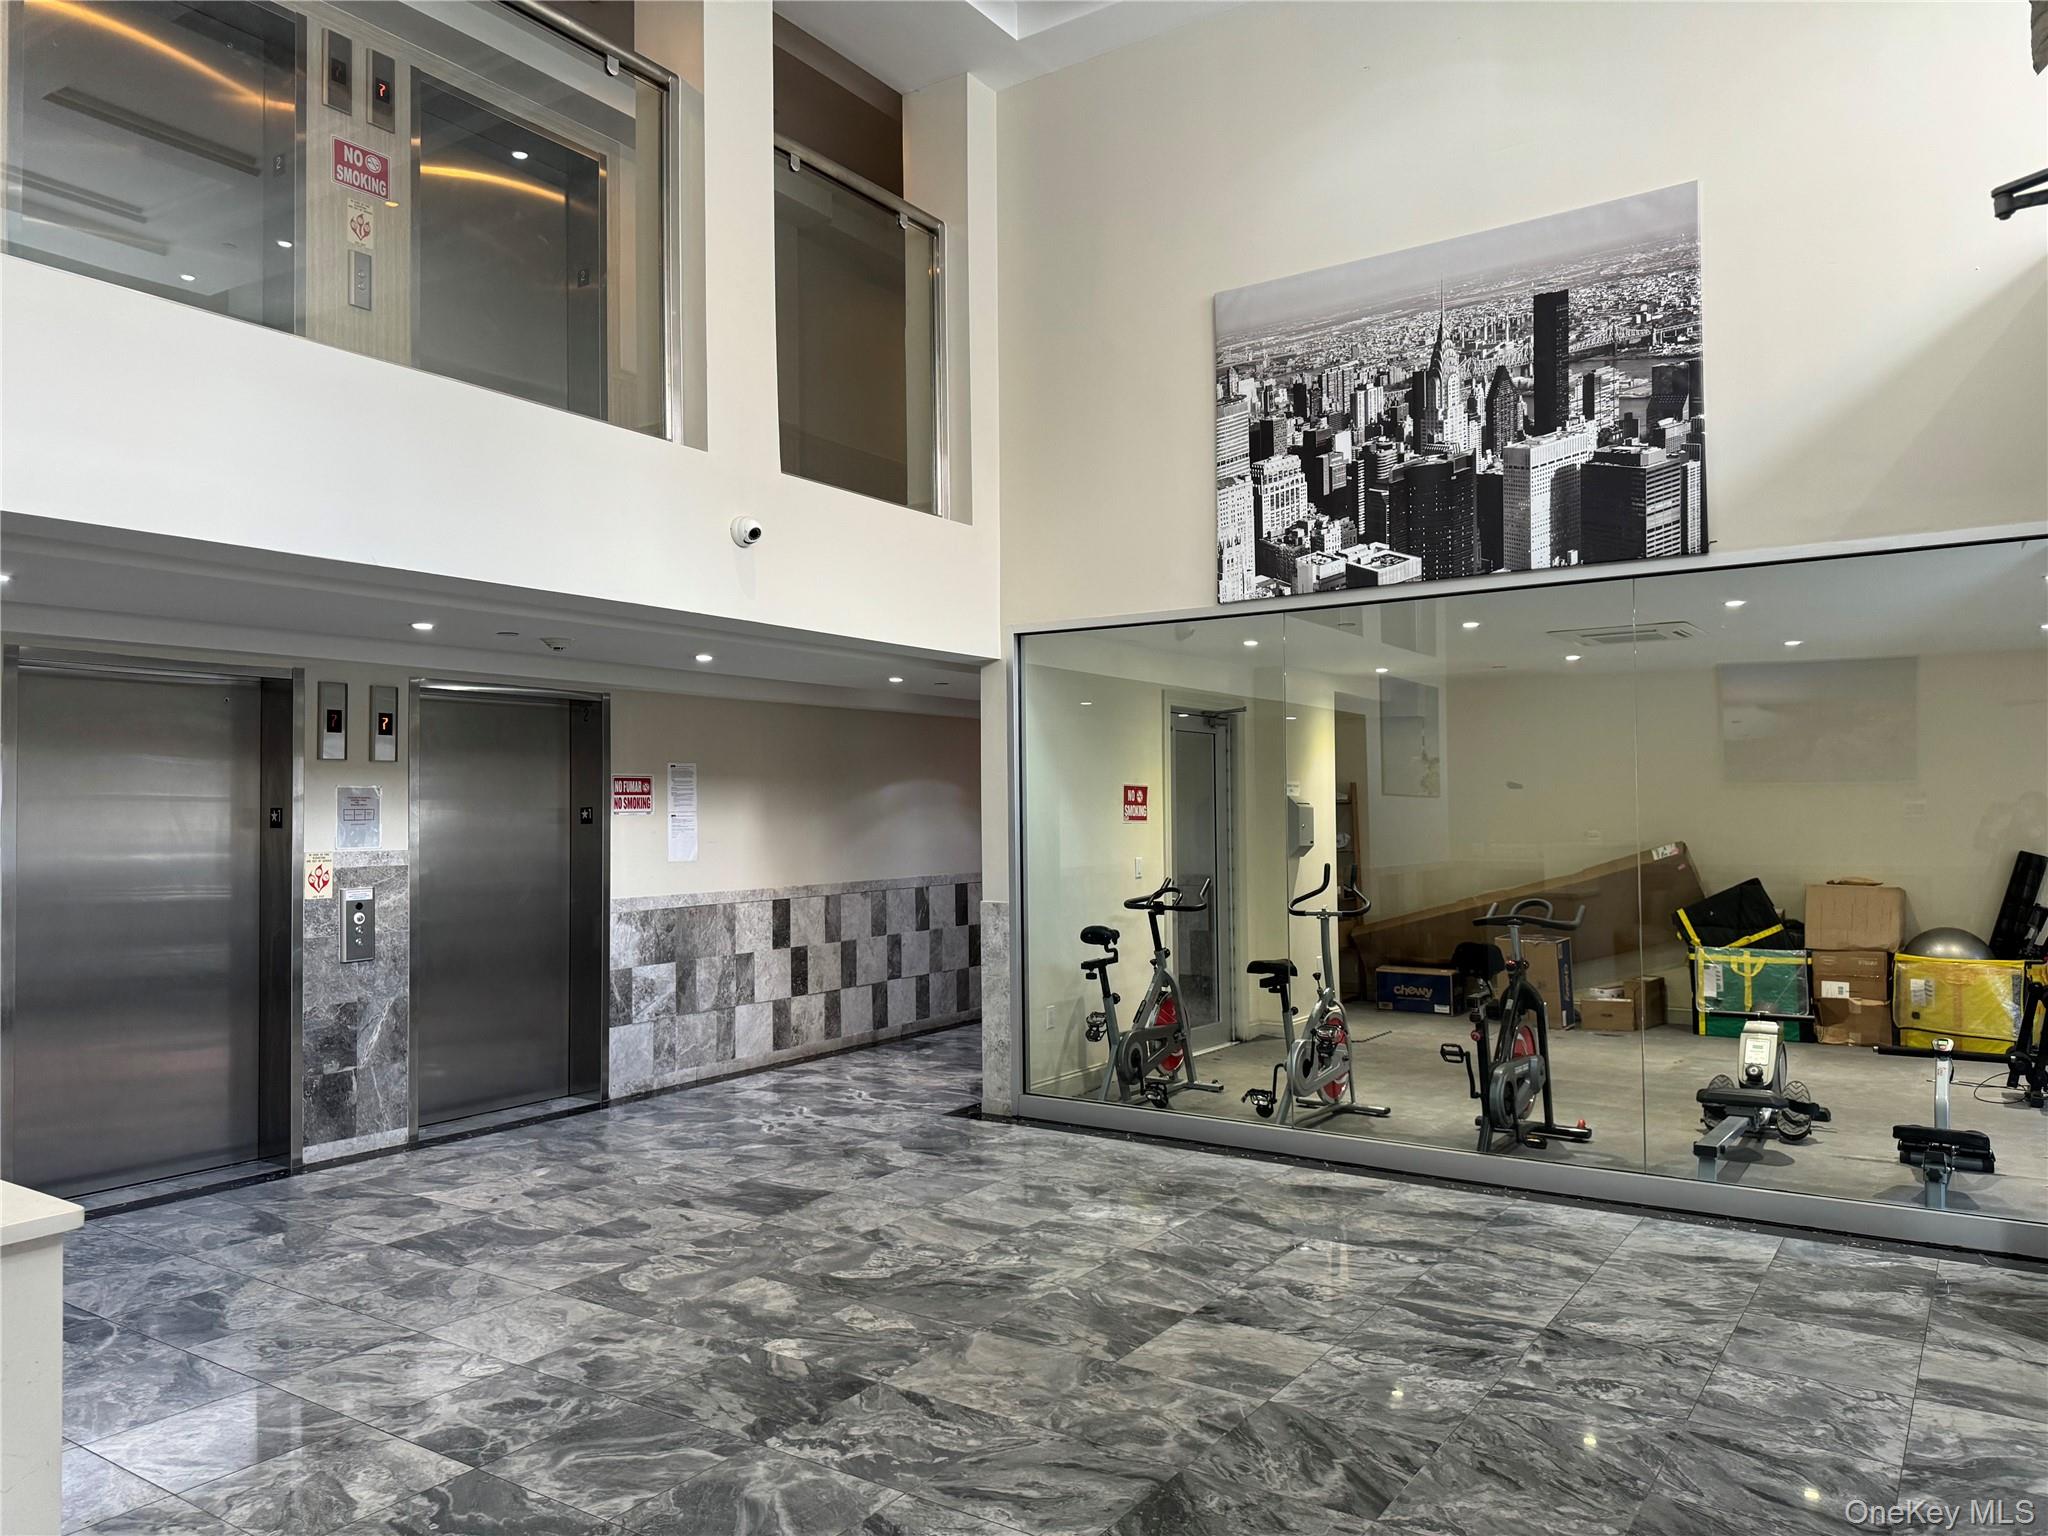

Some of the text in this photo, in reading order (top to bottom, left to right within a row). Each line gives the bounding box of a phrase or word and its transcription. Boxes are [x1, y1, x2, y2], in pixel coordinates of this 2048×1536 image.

[343, 144, 363, 168] NO
[336, 163, 387, 196] SMOKING
[381, 717, 389, 730] 7
[614, 780, 642, 793] NO FUMAR
[614, 796, 651, 810] NO SMOKING
[1124, 804, 1147, 817] SMOKING
[1393, 984, 1433, 999] chewy
